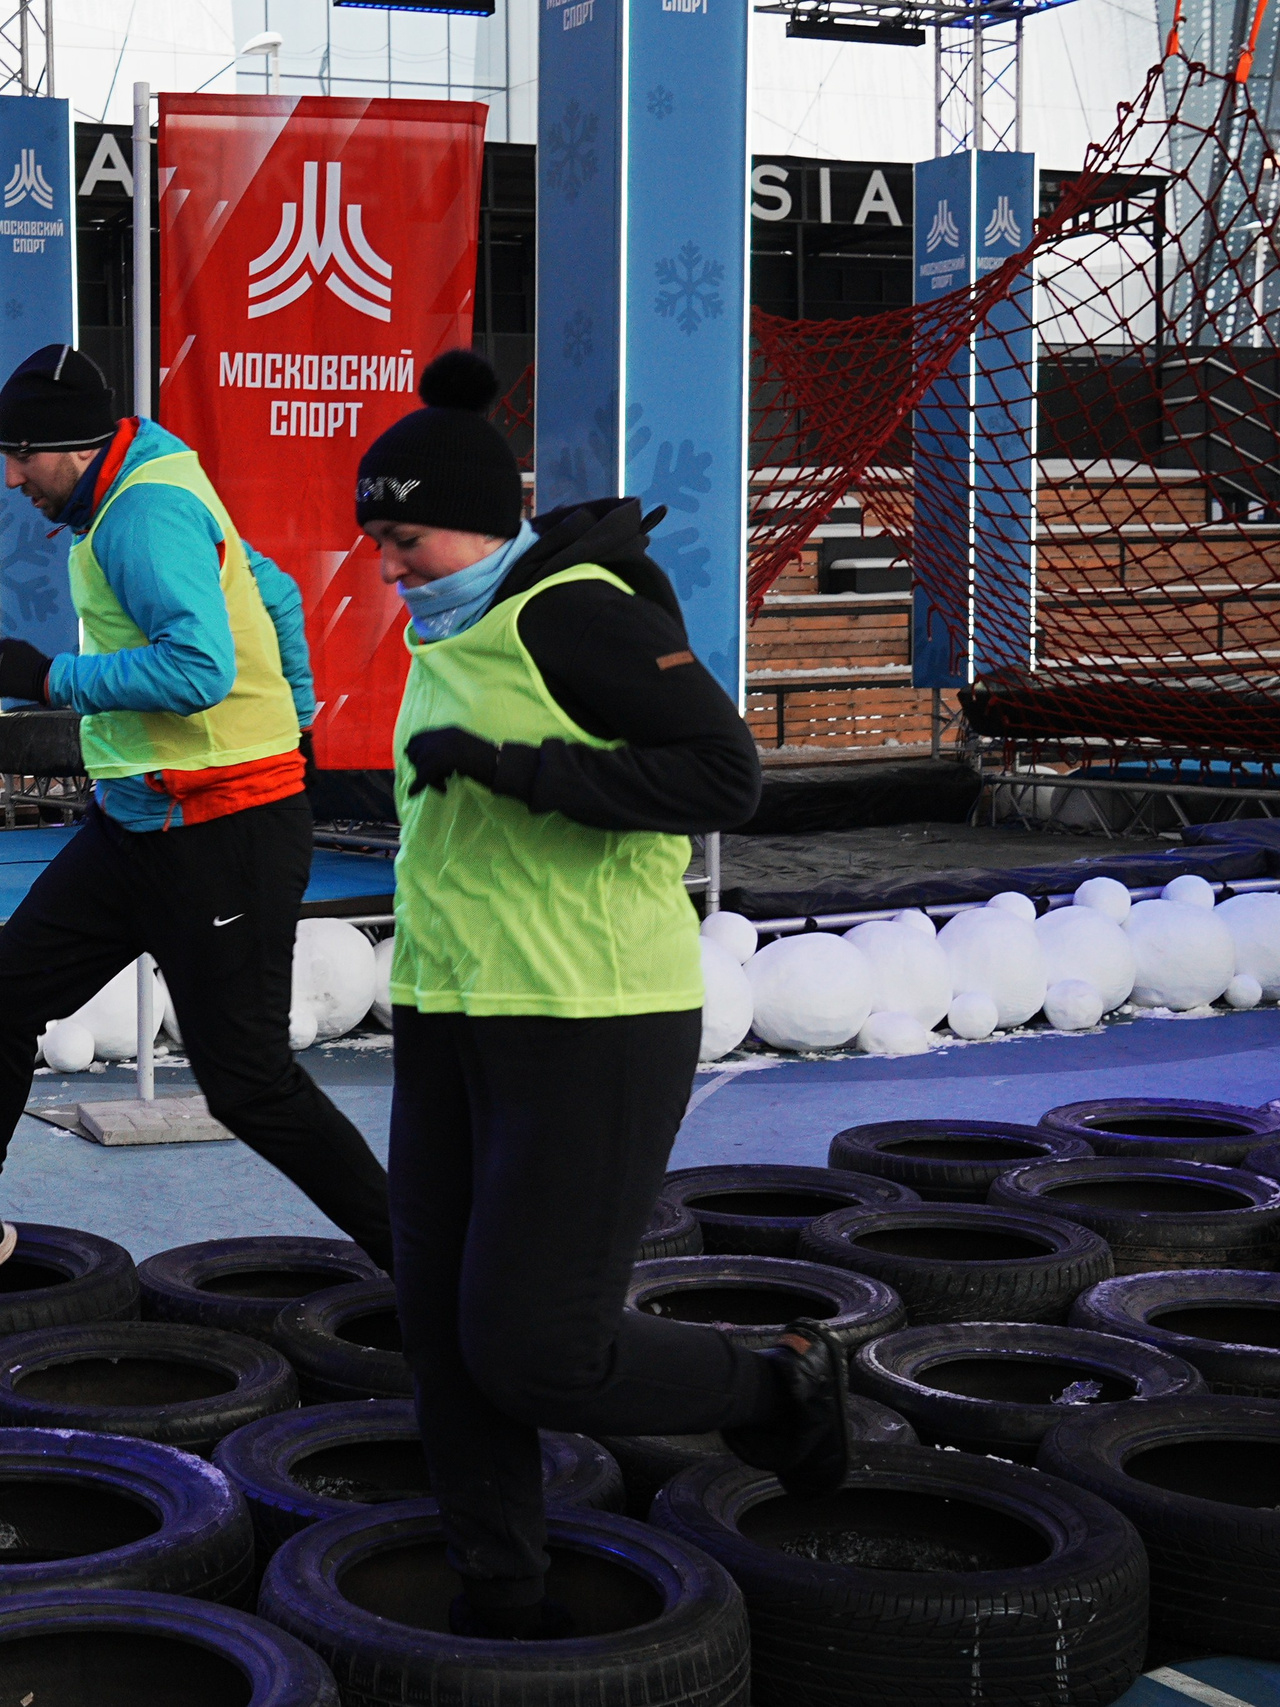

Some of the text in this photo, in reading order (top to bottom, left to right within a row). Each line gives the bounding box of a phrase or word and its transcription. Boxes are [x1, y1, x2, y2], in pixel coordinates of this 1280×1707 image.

[562, 1, 594, 31] СПОРТ
[13, 238, 46, 254] СПОРТ
[219, 349, 414, 392] МОСКОВСКИЙ
[270, 401, 363, 437] СПОРТ
